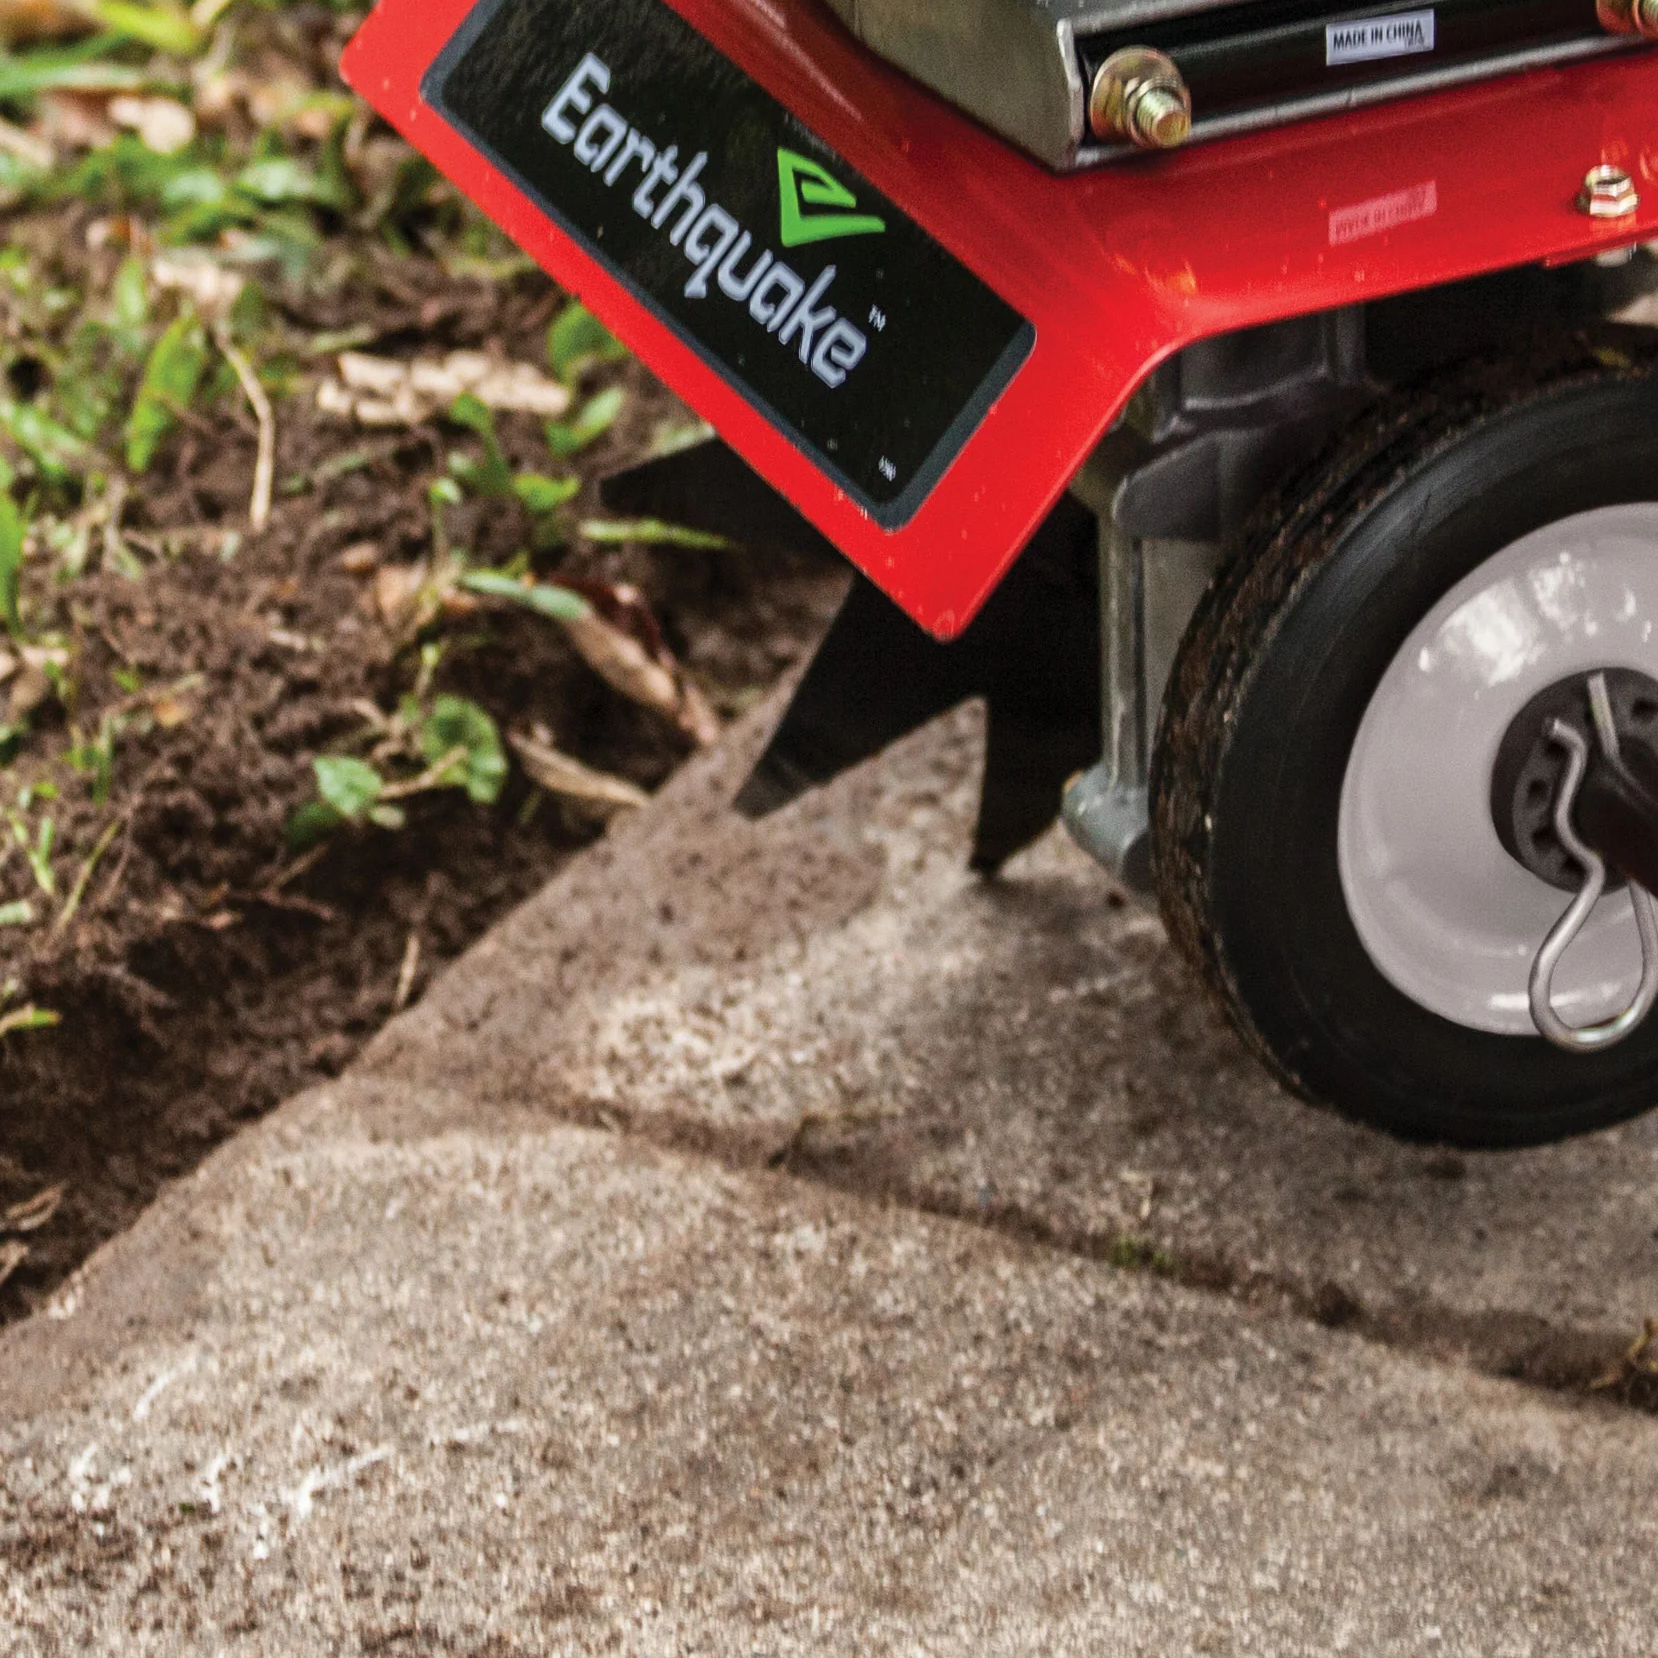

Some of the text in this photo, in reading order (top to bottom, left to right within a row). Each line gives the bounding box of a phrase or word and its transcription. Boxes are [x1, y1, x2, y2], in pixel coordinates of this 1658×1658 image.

[1333, 28, 1366, 51] MADE
[1370, 24, 1383, 46] IN
[1386, 20, 1426, 45] CHINA
[541, 52, 867, 389] Earthquake
